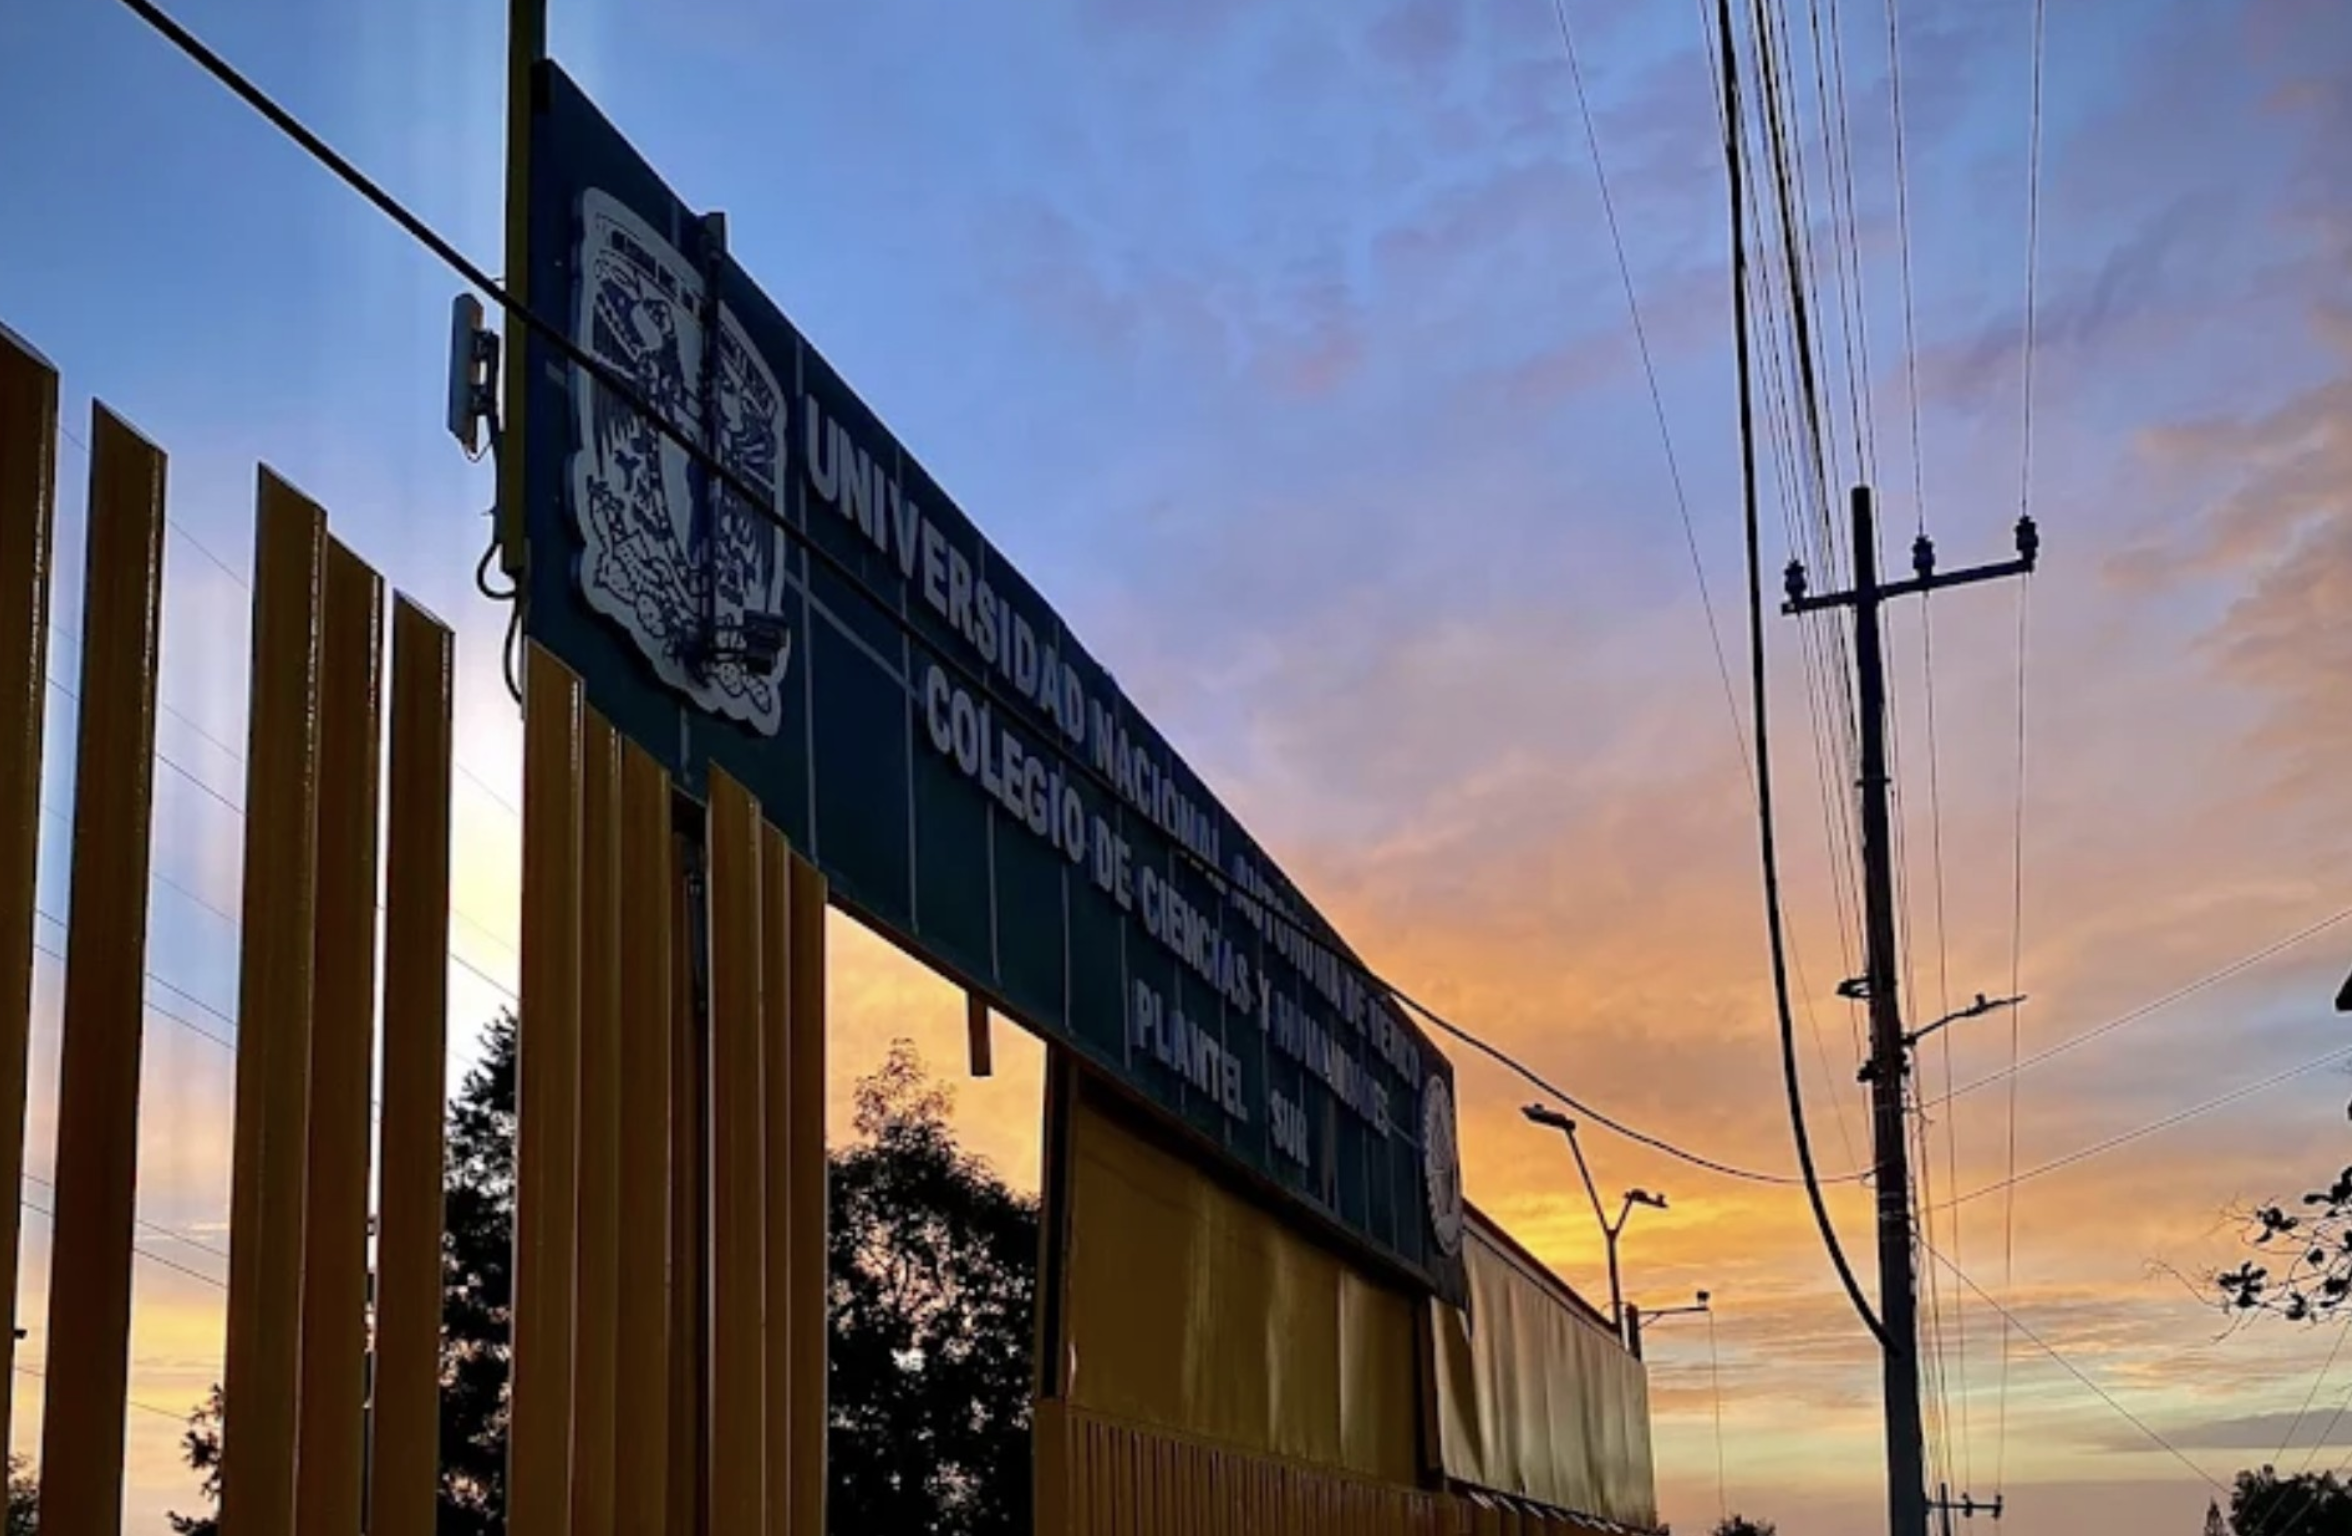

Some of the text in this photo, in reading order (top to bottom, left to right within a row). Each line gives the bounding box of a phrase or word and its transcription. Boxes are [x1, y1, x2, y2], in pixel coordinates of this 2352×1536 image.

[806, 394, 1086, 744] UNIVERSIDAD
[926, 665, 1086, 864] COLEGIO
[1091, 814, 1132, 911] DE
[1141, 865, 1252, 1015] CIENCIAS
[1256, 968, 1270, 1033] Y
[1131, 977, 1310, 1168] PLANTEL SUR
